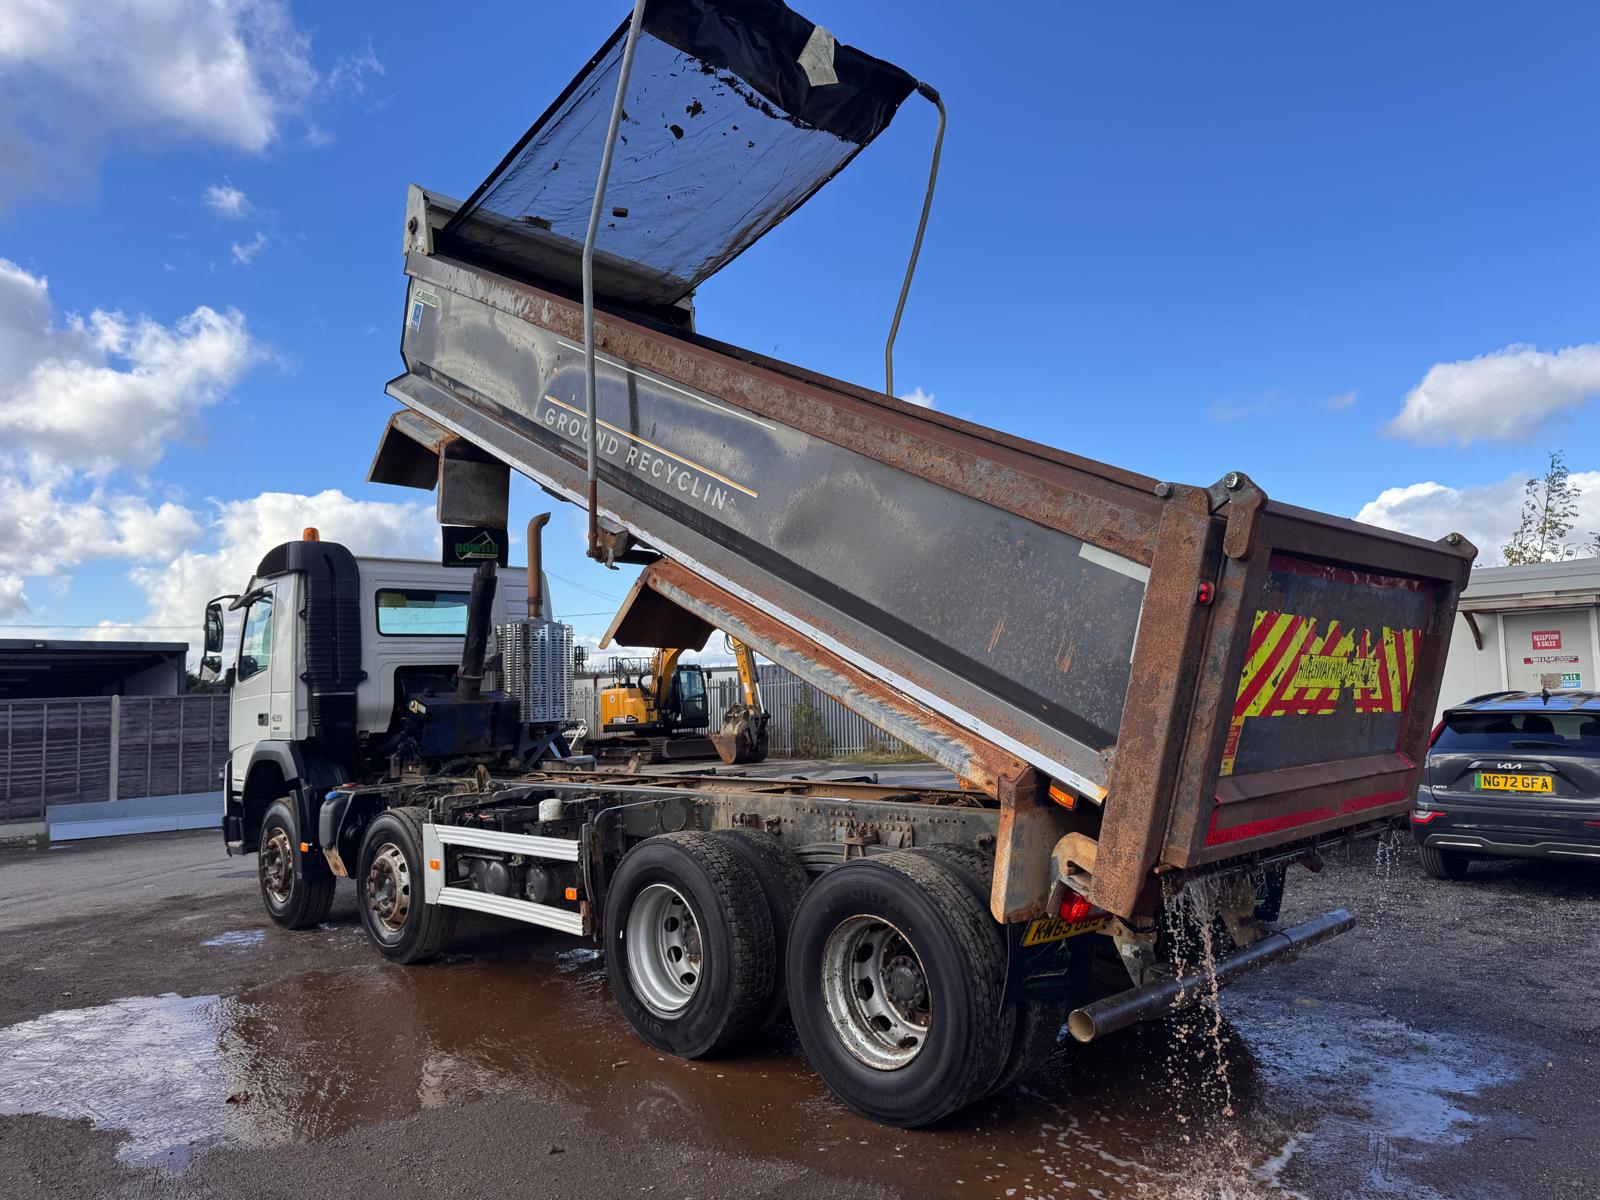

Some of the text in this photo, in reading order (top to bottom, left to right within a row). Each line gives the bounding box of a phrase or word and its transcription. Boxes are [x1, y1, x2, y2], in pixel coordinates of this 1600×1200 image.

[626, 445, 736, 511] RECYCLIN
[1483, 775, 1548, 789] NG72 GFA
